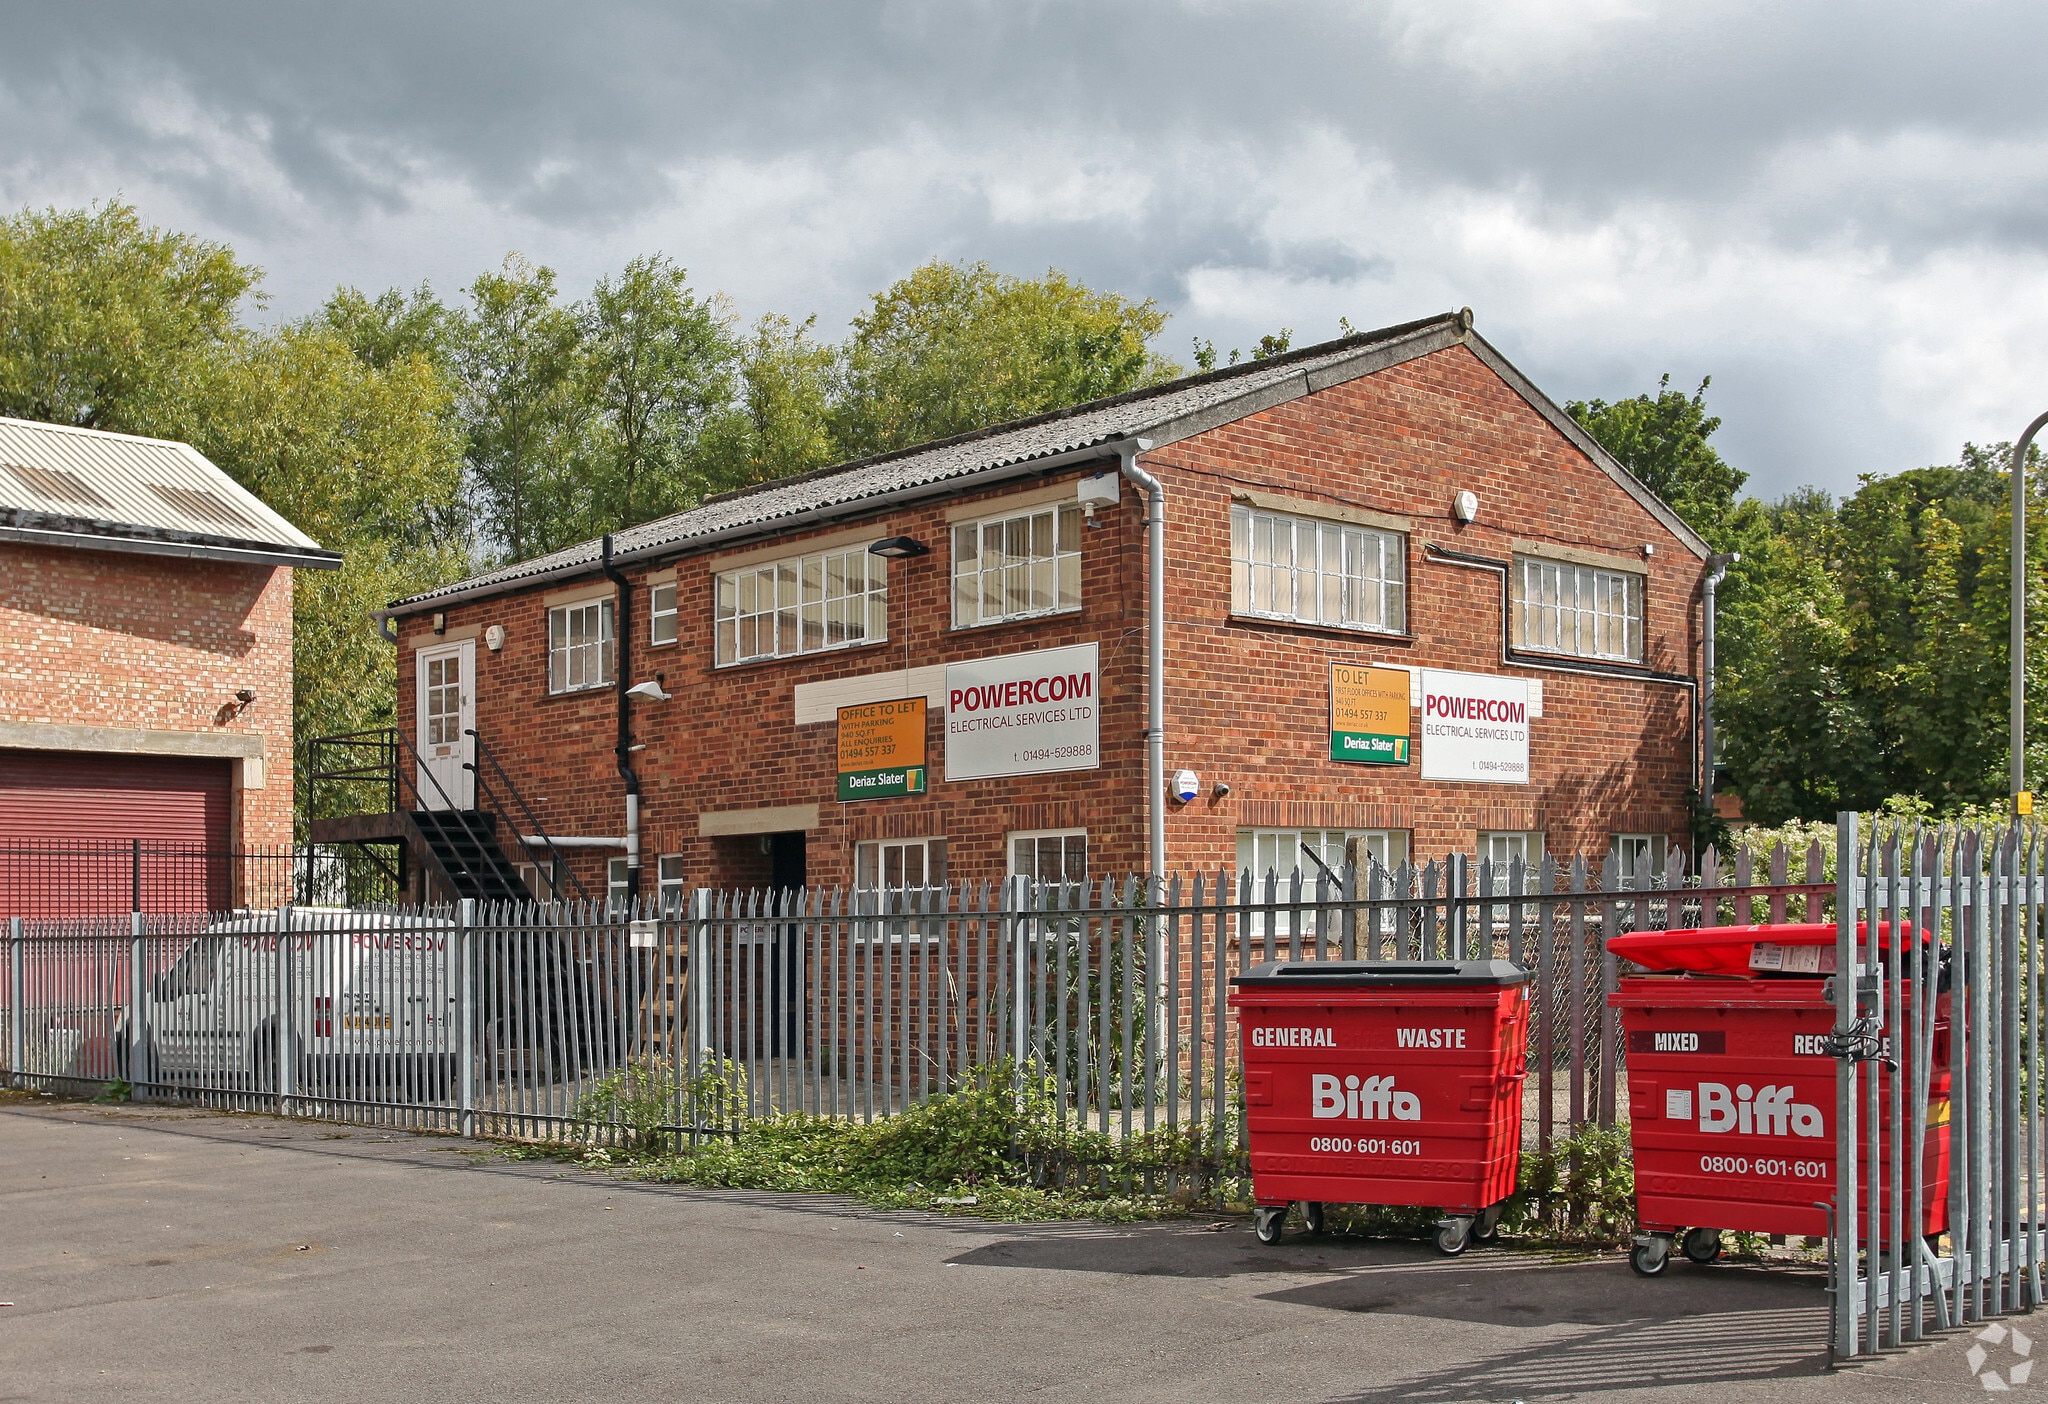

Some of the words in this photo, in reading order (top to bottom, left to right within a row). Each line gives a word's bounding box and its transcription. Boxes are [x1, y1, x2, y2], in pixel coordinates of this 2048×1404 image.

[1335, 668, 1350, 683] TO
[1353, 670, 1369, 685] LET
[950, 672, 1091, 713] POWERCOM
[1347, 687, 1362, 696] FLOOR
[1362, 689, 1377, 698] OFFICES
[841, 707, 876, 720] OFFICE
[879, 704, 894, 715] TO
[897, 702, 917, 713] LET
[1335, 708, 1358, 718] 01494
[1360, 709, 1373, 720] 557
[1375, 711, 1388, 721] 337
[1426, 694, 1524, 723] POWERCOM
[841, 722, 860, 730] WITH
[861, 718, 895, 728] PARKING
[951, 715, 1013, 733] ELECTRICAL
[1016, 709, 1066, 726] SERVICES
[1069, 707, 1092, 720] LTD
[840, 731, 854, 739] 940
[855, 729, 875, 738] SQ.FT
[854, 736, 893, 746] ENQUIRIES
[1426, 724, 1473, 738] ELECTRICAL
[1475, 727, 1508, 741] SERVICES
[1510, 730, 1525, 741] LTD
[840, 748, 863, 759] 01494
[865, 746, 880, 757] 557
[882, 744, 896, 755] 337
[1344, 735, 1370, 750] Deriaz
[1371, 738, 1394, 751] Slater
[1014, 752, 1020, 762] t.
[1023, 744, 1092, 762] 01494-529888
[1479, 760, 1525, 772] 01494-529888
[849, 775, 876, 788] Deriaz
[877, 773, 905, 785] Slater
[1252, 1027, 1337, 1047] GENERAL
[1396, 1028, 1466, 1049] WASTE
[1655, 1032, 1699, 1052] MIXED
[1794, 1034, 1891, 1057] RECYE
[1312, 1073, 1421, 1121] Biffa
[1698, 1082, 1824, 1138] Biffa
